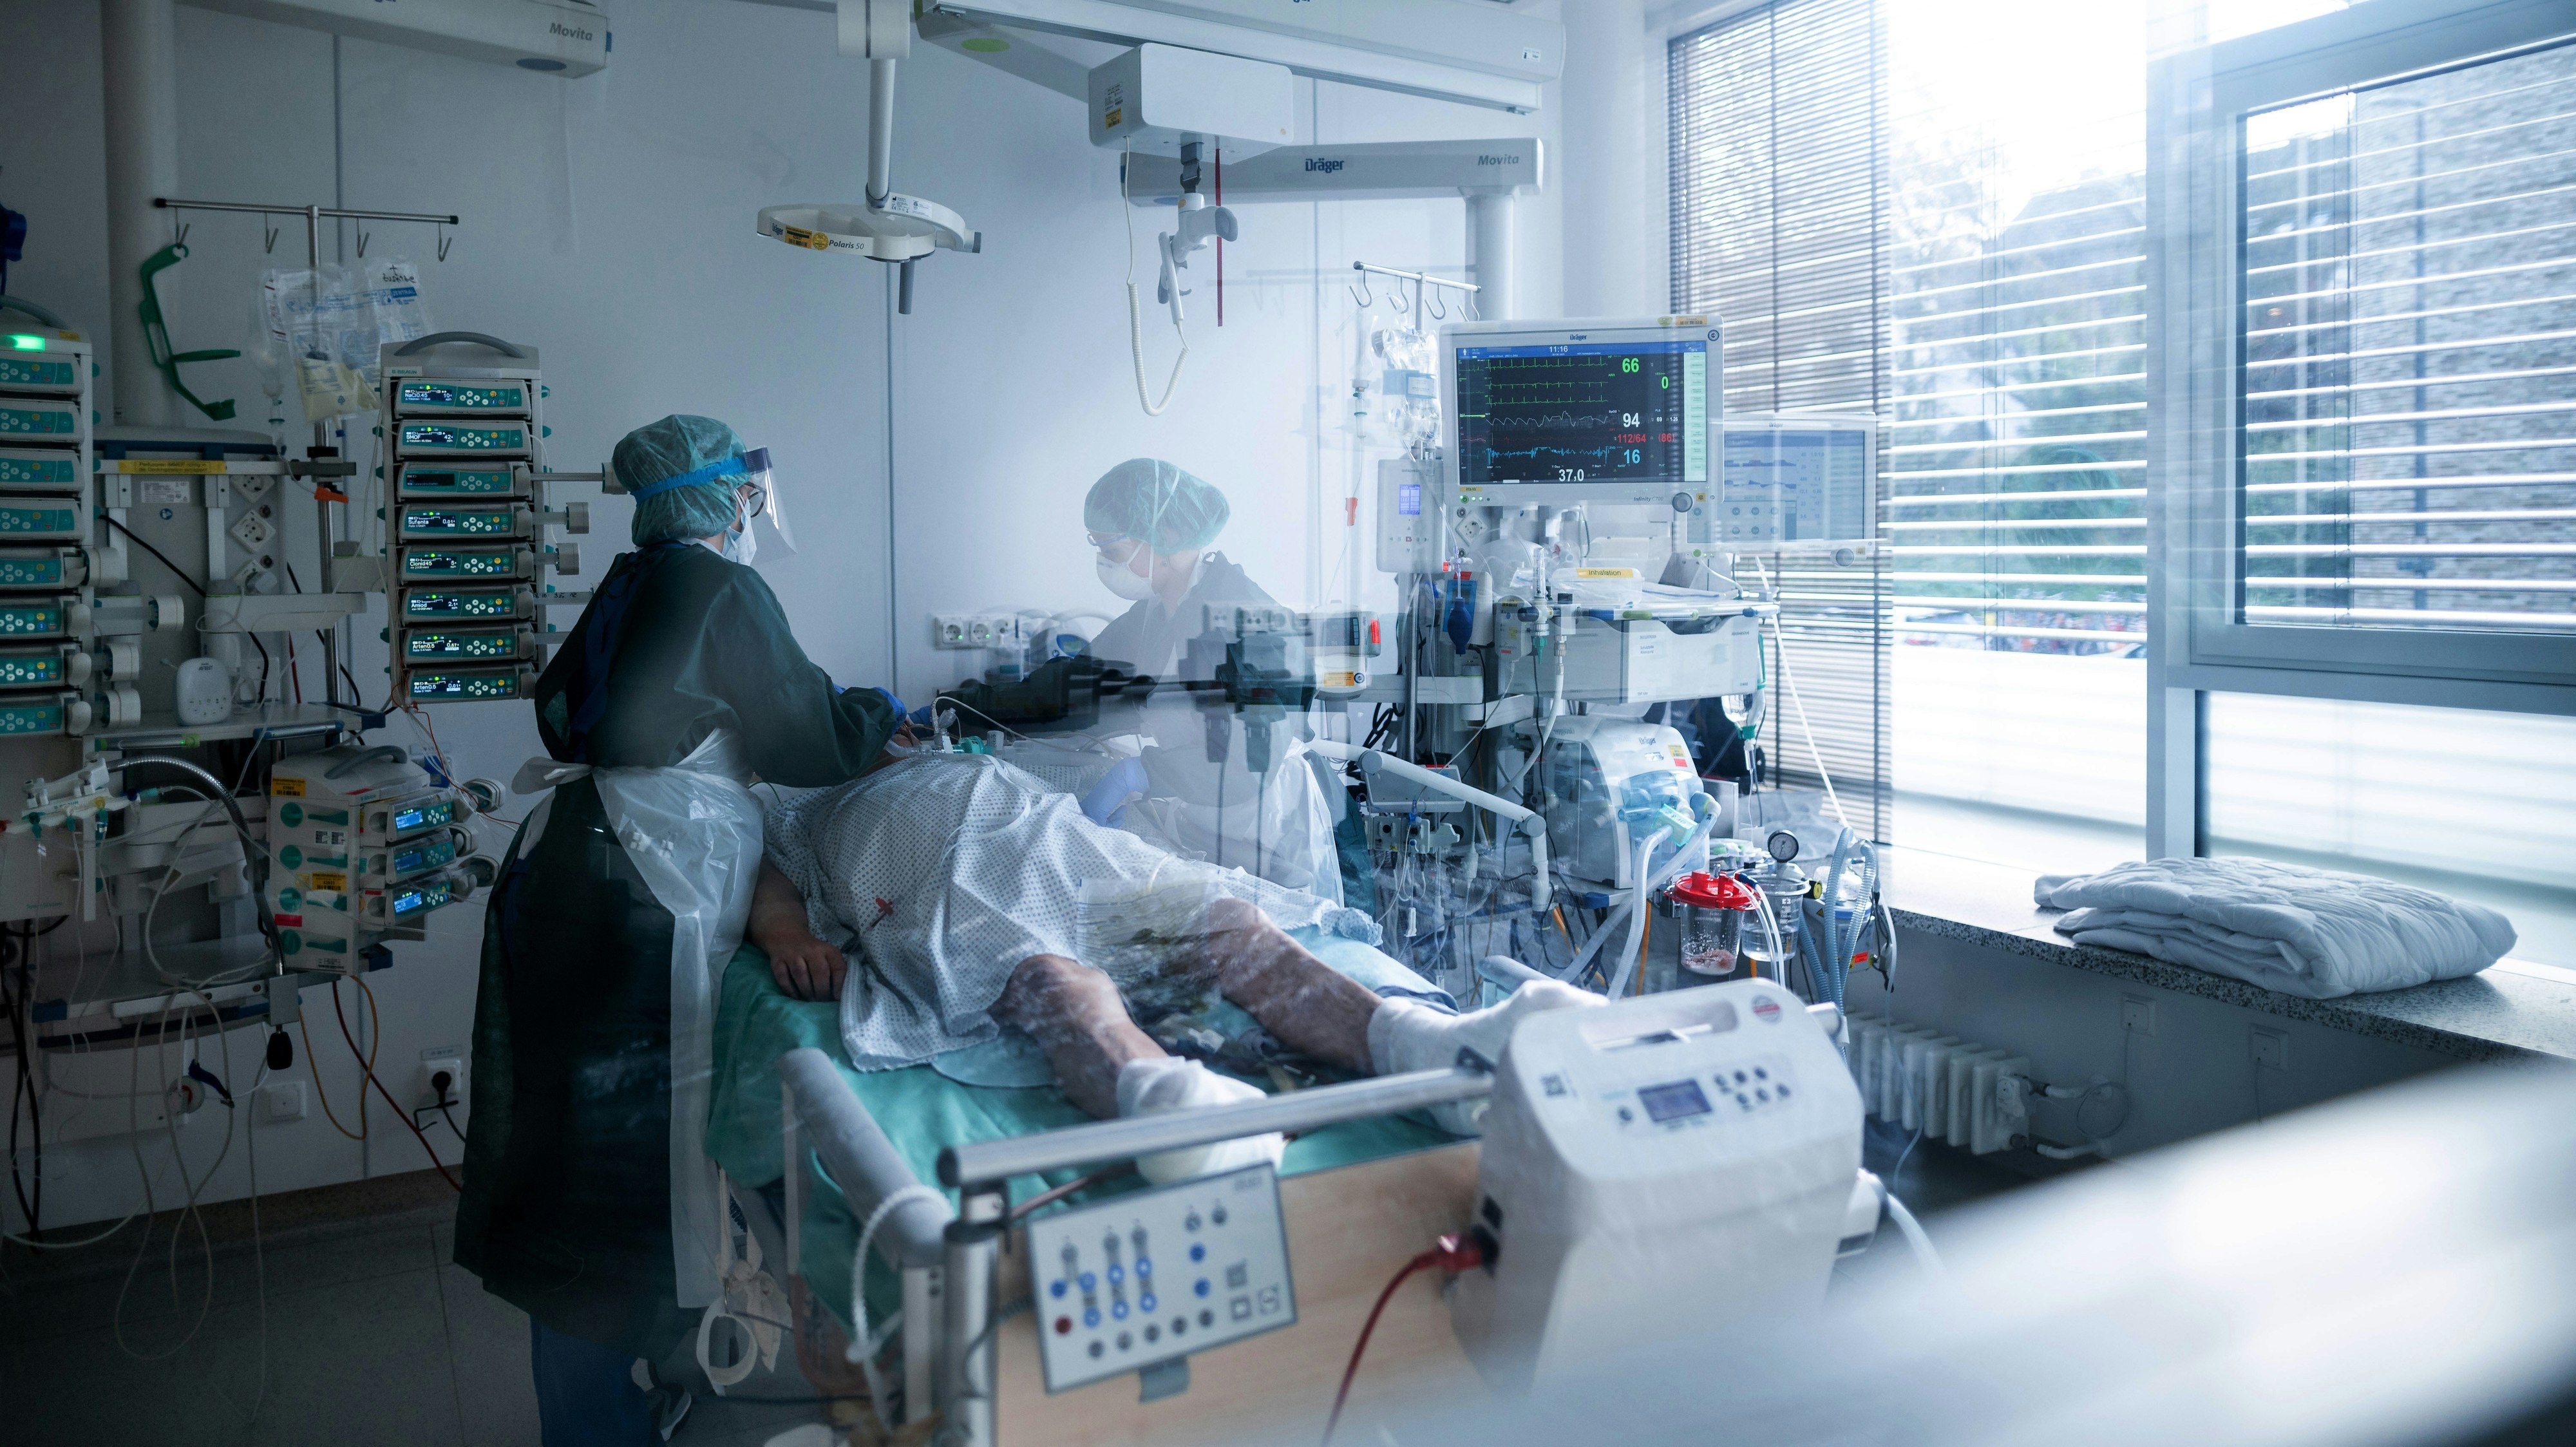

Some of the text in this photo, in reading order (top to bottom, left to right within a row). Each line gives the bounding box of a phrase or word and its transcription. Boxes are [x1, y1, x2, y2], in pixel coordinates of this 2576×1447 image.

[550, 23, 592, 41] Movita
[1305, 158, 1345, 173] Dräger
[1478, 154, 1520, 167] Movita
[829, 240, 854, 249] Polaris
[1622, 357, 1640, 373] 66
[1661, 376, 1669, 390] 0
[1623, 412, 1640, 428] 94
[1617, 433, 1647, 444] 112/64
[1658, 433, 1676, 443] (86)
[1624, 449, 1640, 464] 16
[1558, 469, 1584, 482] 37,0
[1638, 737, 1656, 745] Dräger
